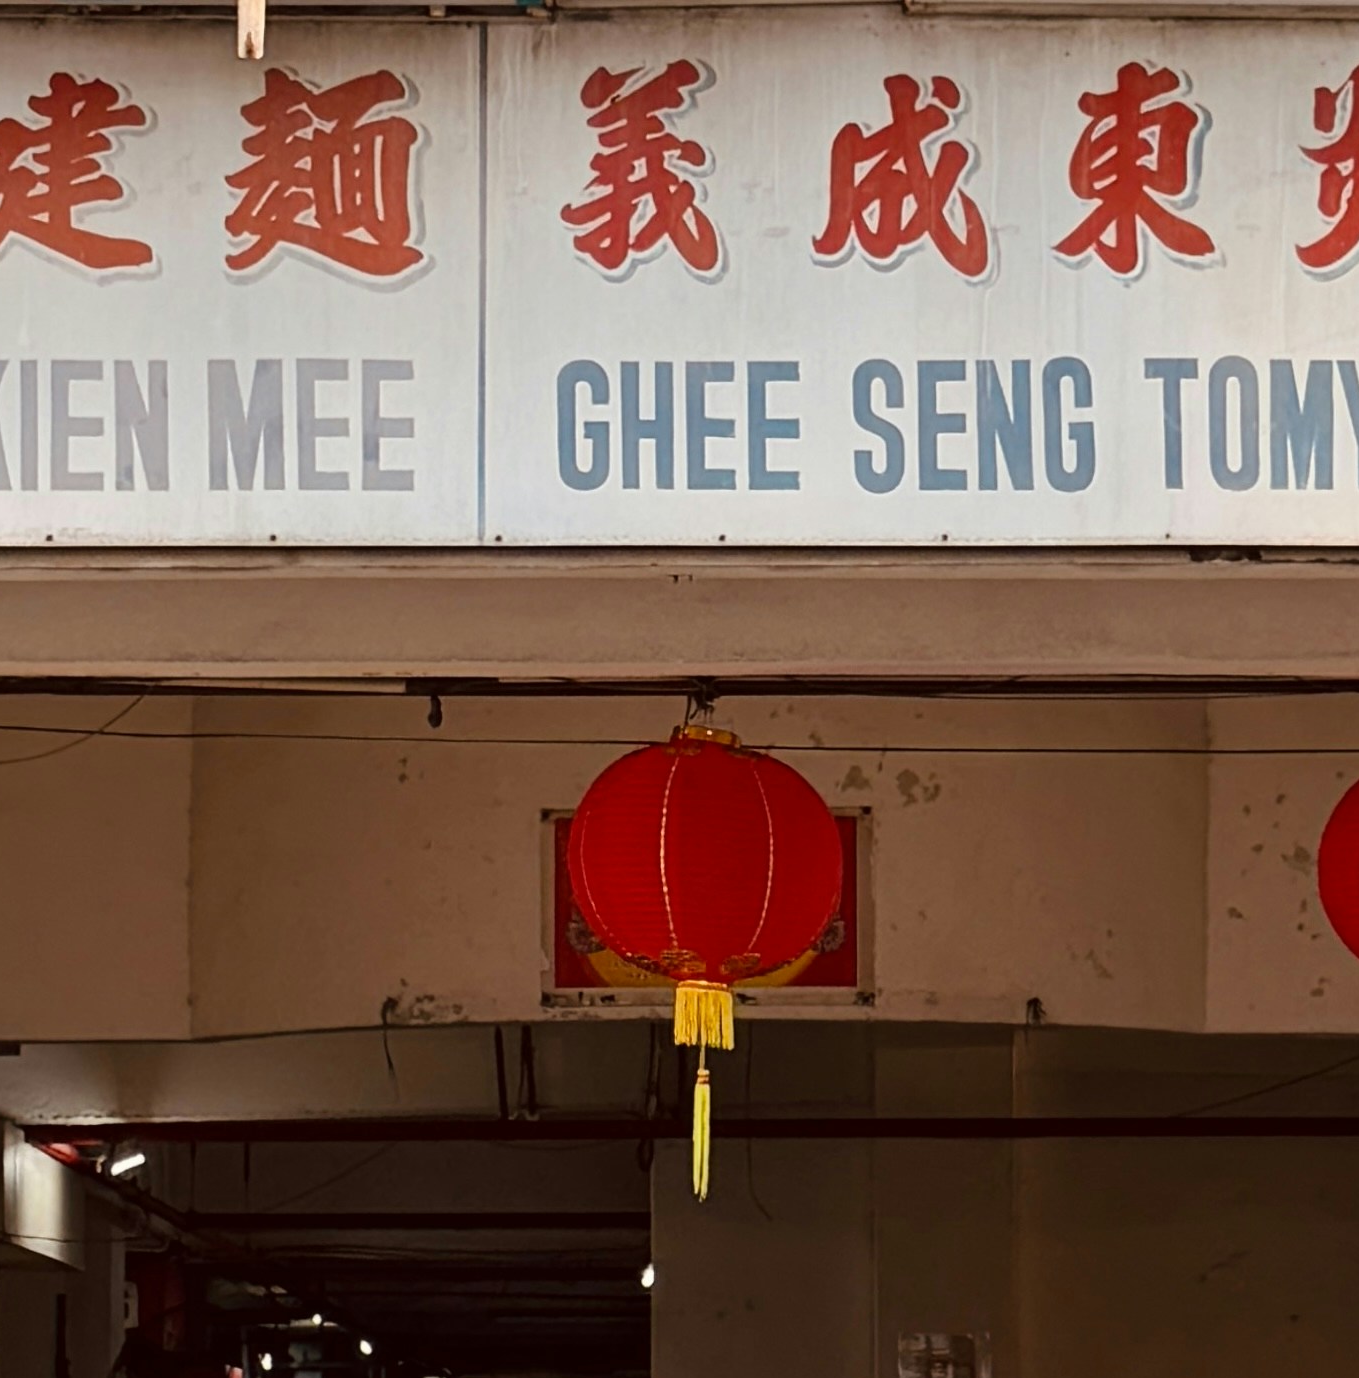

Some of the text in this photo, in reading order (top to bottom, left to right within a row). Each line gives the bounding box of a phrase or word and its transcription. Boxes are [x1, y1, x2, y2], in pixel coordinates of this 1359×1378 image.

[207, 357, 415, 492] MEE
[556, 359, 801, 493] GHEE
[852, 356, 1096, 494] SENG
